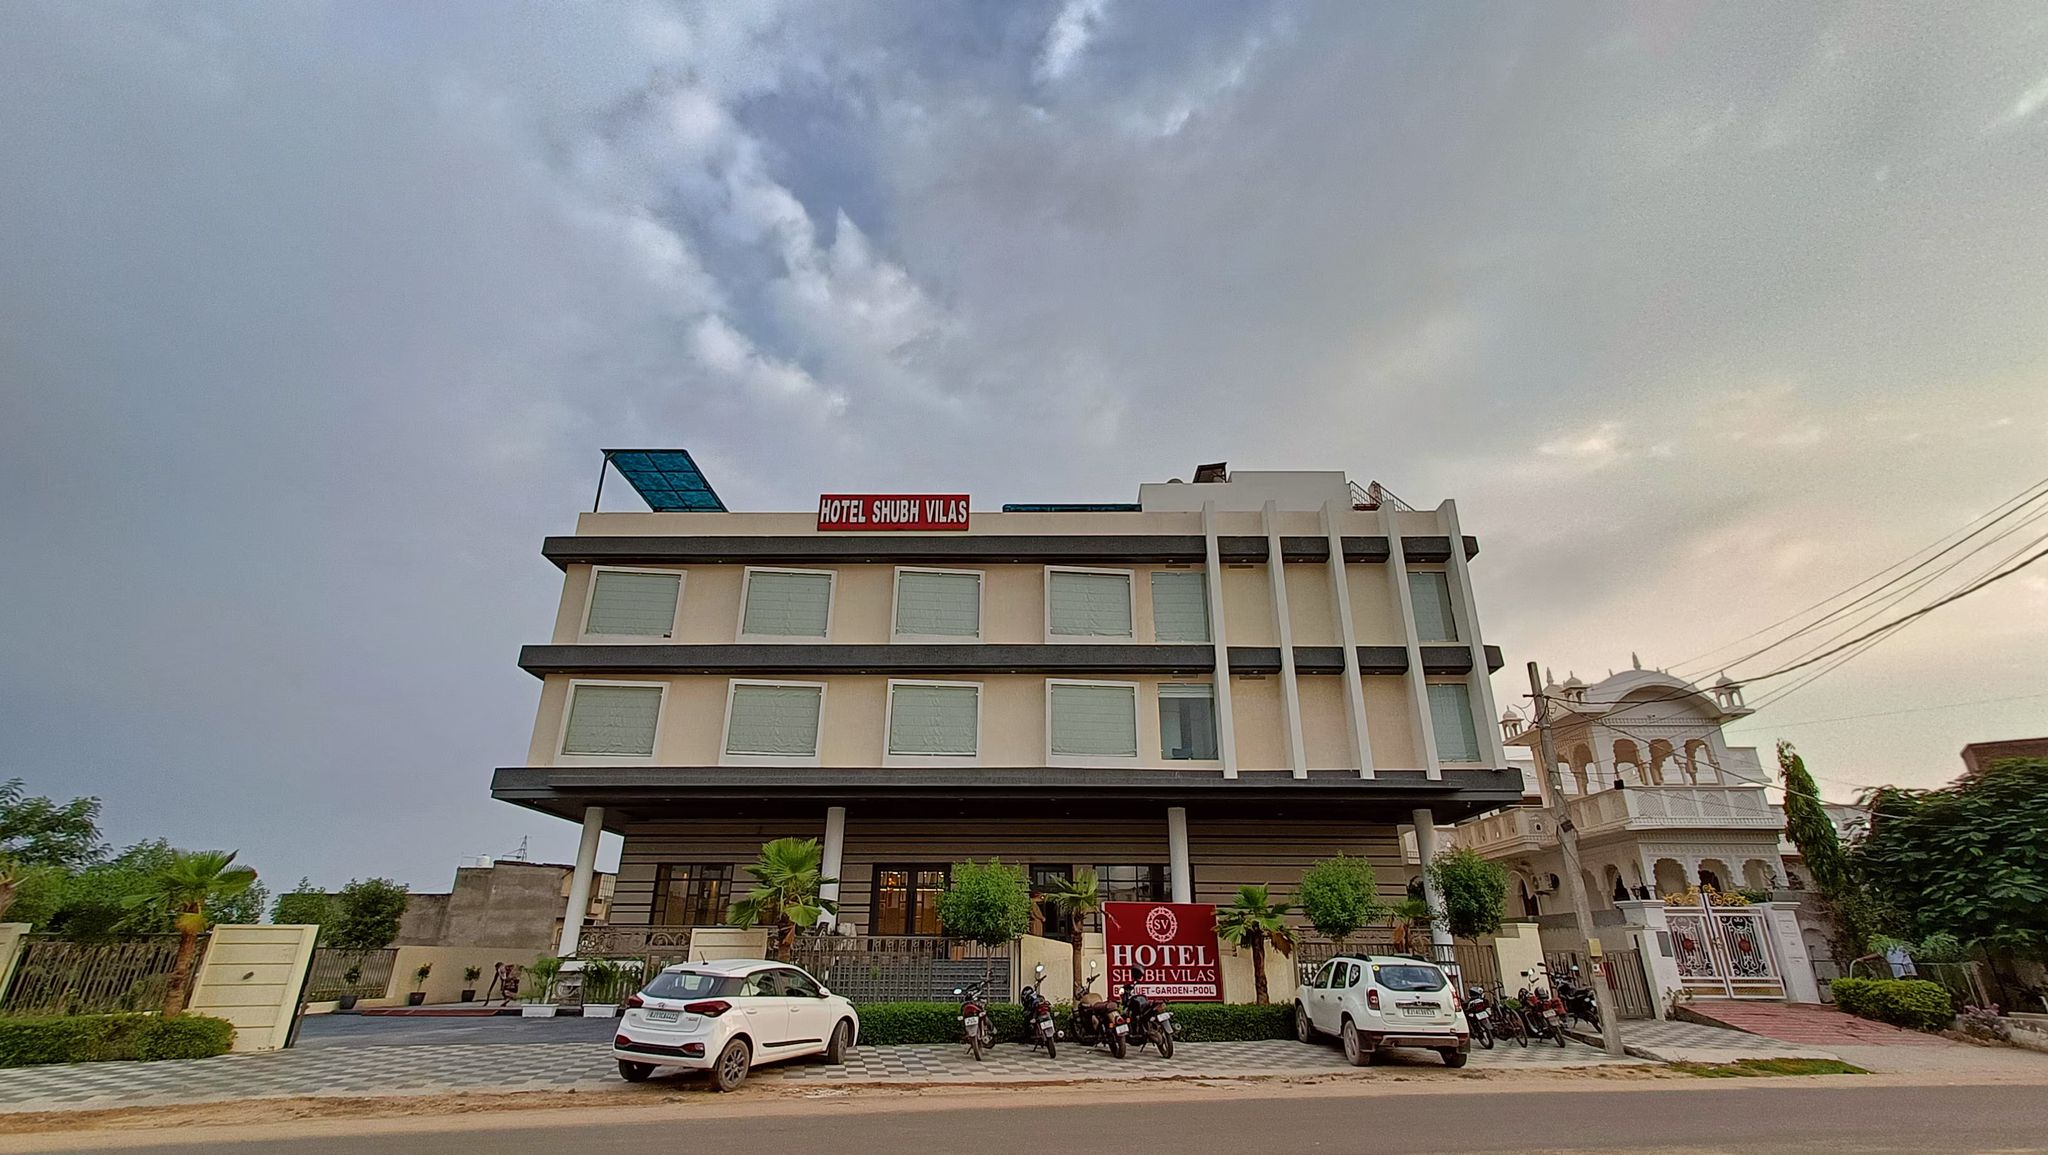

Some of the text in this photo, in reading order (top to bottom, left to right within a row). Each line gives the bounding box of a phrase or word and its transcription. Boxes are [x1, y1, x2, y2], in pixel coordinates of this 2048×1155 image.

[820, 499, 967, 523] HOTEL SHUBH VILAS
[1153, 919, 1169, 930] SV
[1111, 944, 1215, 967] HOTEL
[1112, 968, 1216, 982] SHBH VILAS
[1114, 986, 1215, 995] BUET-GARDEN-POOL
